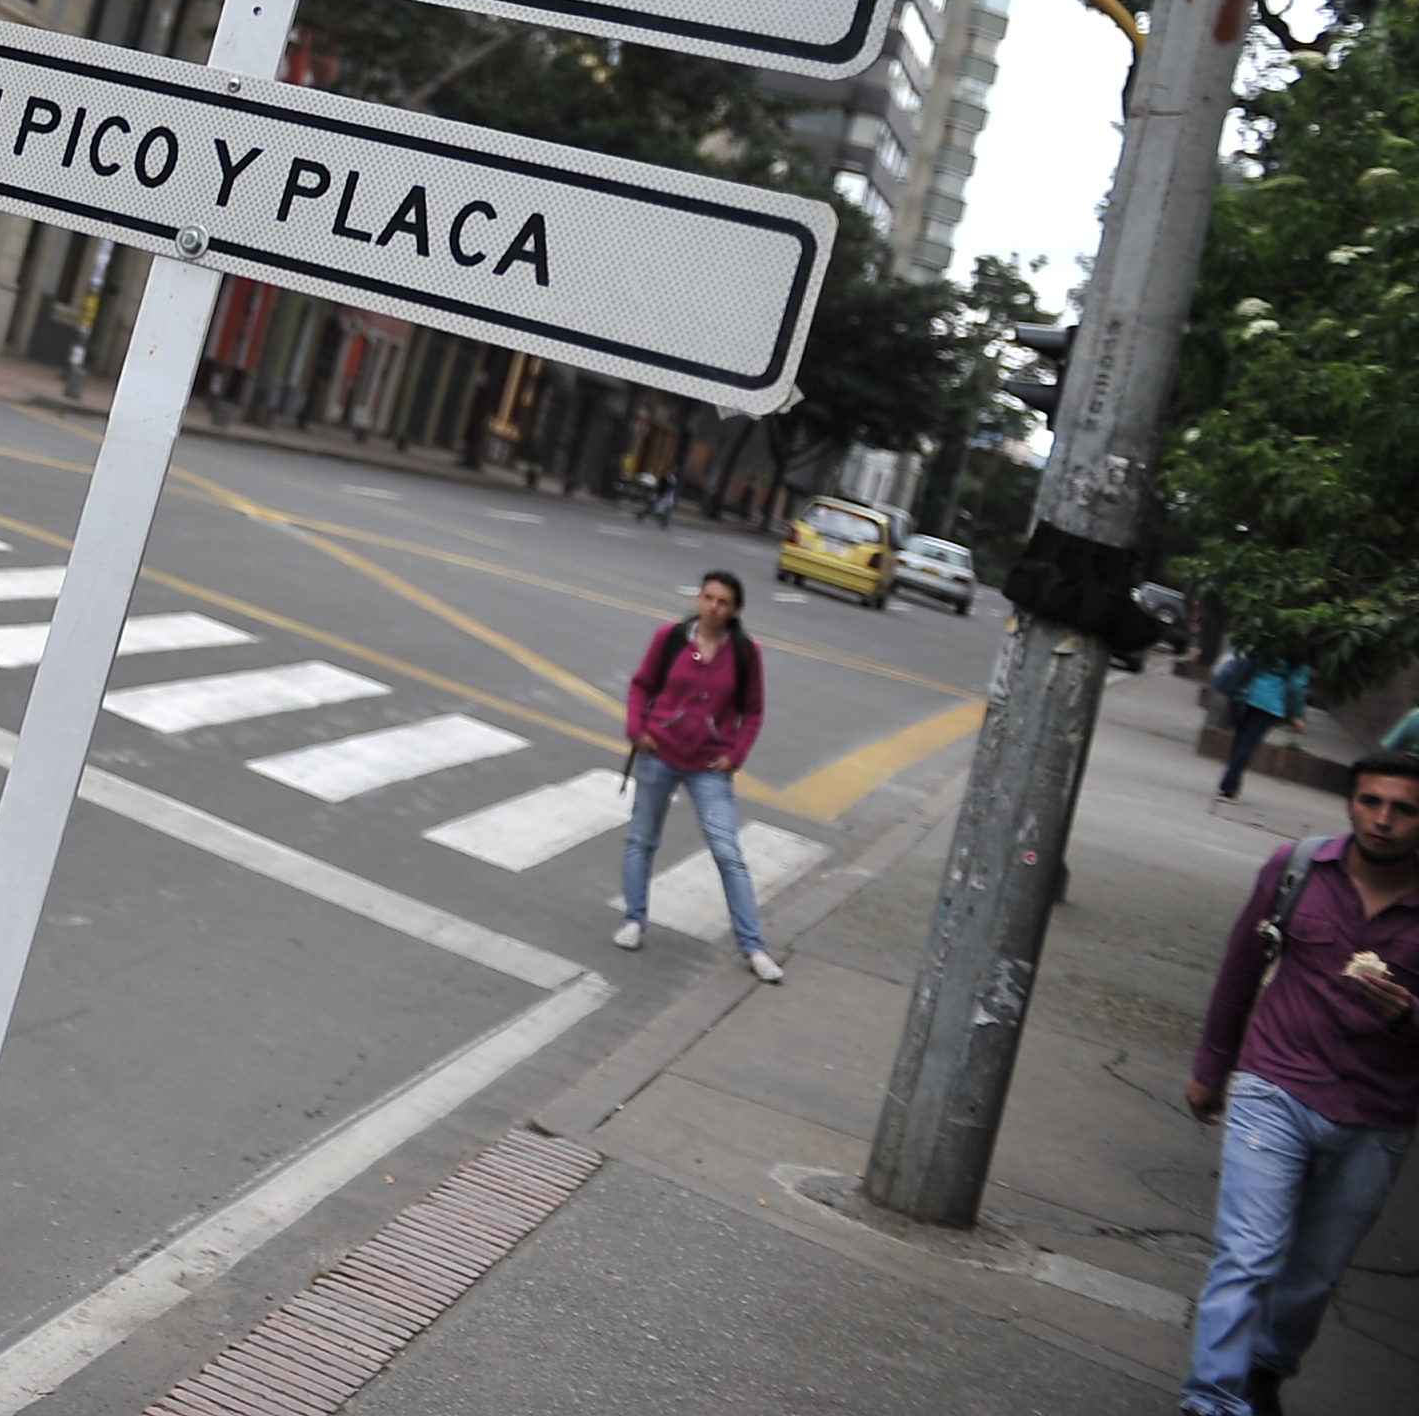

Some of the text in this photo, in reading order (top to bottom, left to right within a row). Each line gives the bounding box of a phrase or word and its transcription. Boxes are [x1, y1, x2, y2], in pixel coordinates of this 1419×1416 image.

[14, 96, 178, 188] PICO
[214, 139, 263, 207] Y
[276, 157, 549, 286] PLACA
